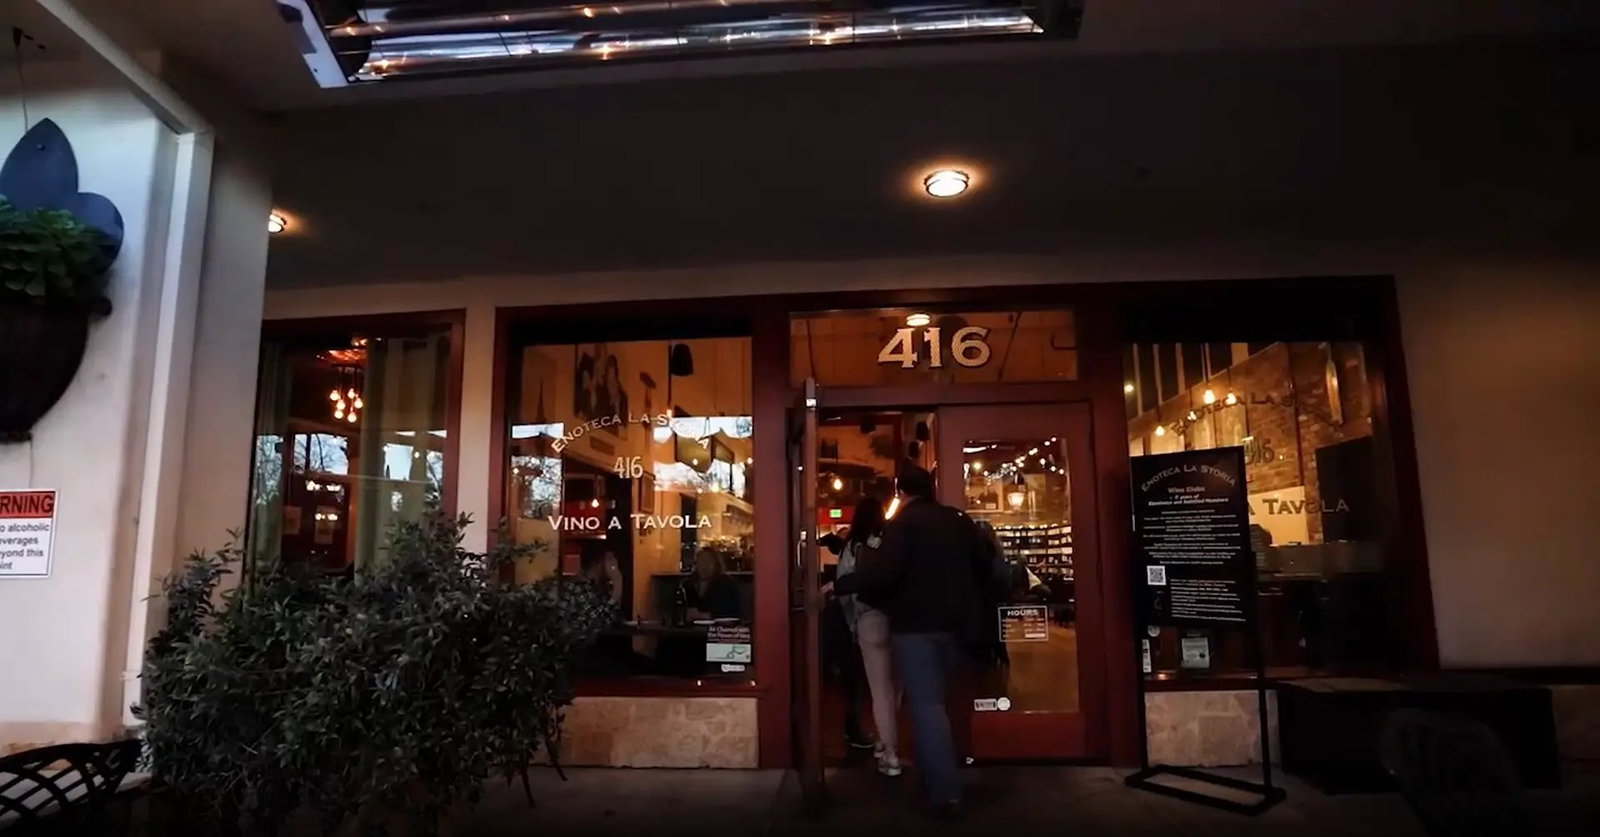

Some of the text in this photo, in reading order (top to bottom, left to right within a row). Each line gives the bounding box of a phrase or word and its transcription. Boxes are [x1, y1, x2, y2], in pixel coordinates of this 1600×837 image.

[878, 326, 991, 368] 416
[551, 413, 710, 453] ENOTECA LA STOIA
[613, 455, 643, 479] 416
[1141, 467, 1180, 492] ENOTECA
[1201, 465, 1235, 487] STORIA
[1262, 498, 1350, 515] TAVOLA
[8, 523, 50, 532] alcoholic
[548, 514, 712, 530] VINO A TAVOLA
[0, 536, 39, 546] verages
[0, 549, 43, 559] yond this
